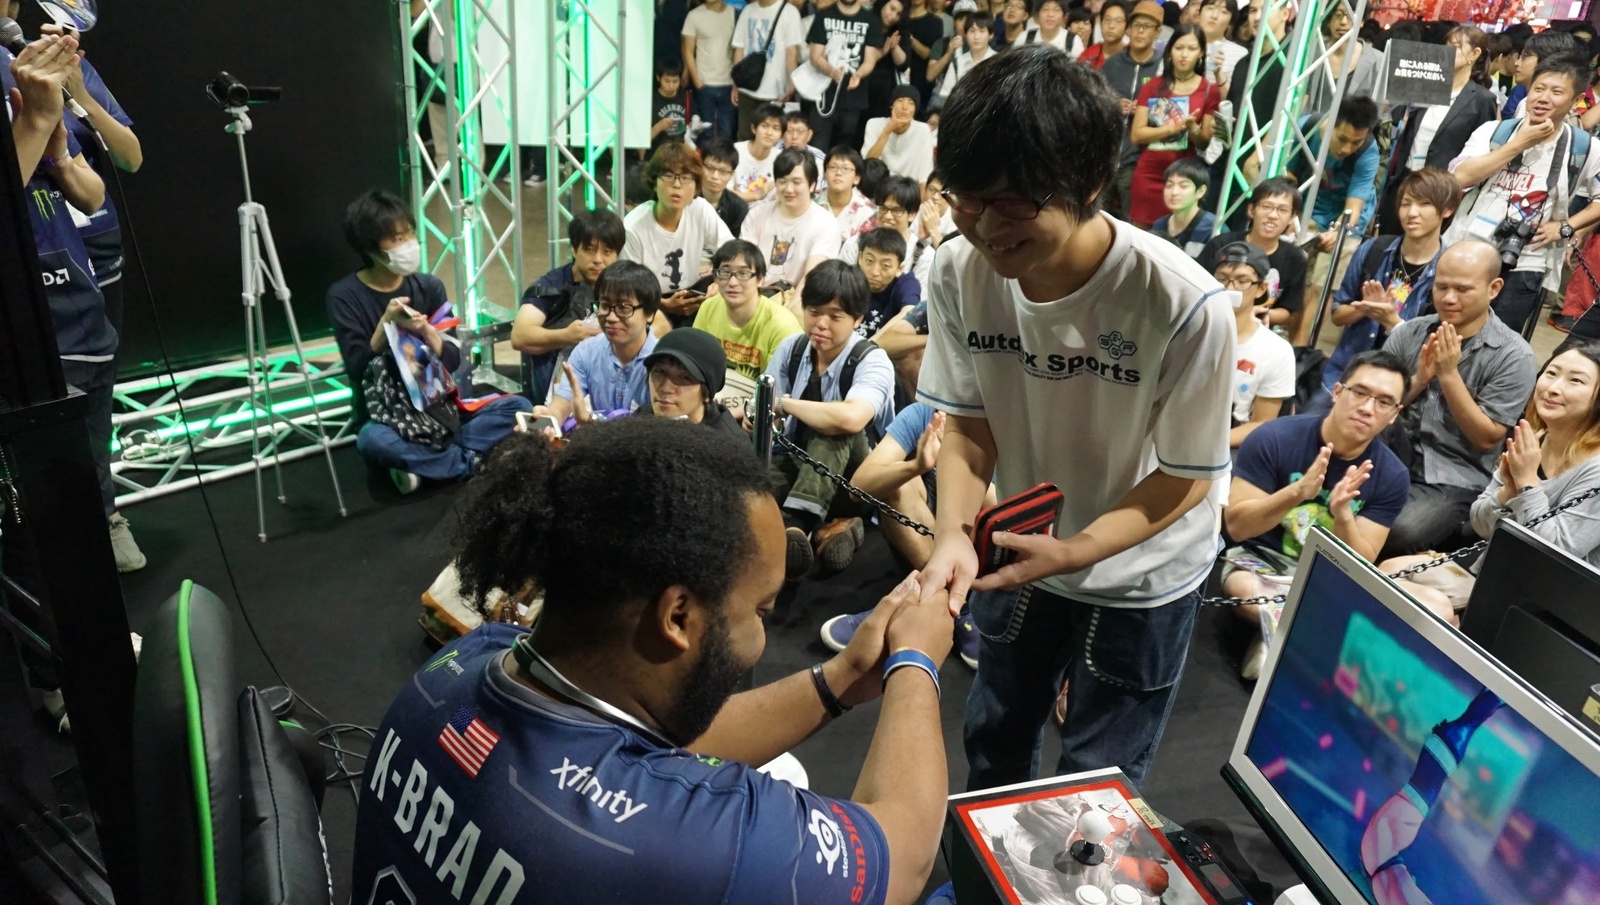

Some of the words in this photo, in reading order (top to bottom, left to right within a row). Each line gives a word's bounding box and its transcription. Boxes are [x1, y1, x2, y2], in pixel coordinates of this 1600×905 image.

[824, 18, 869, 35] BULLET
[1047, 354, 1141, 383] Sports
[370, 727, 525, 905] K-BRAD
